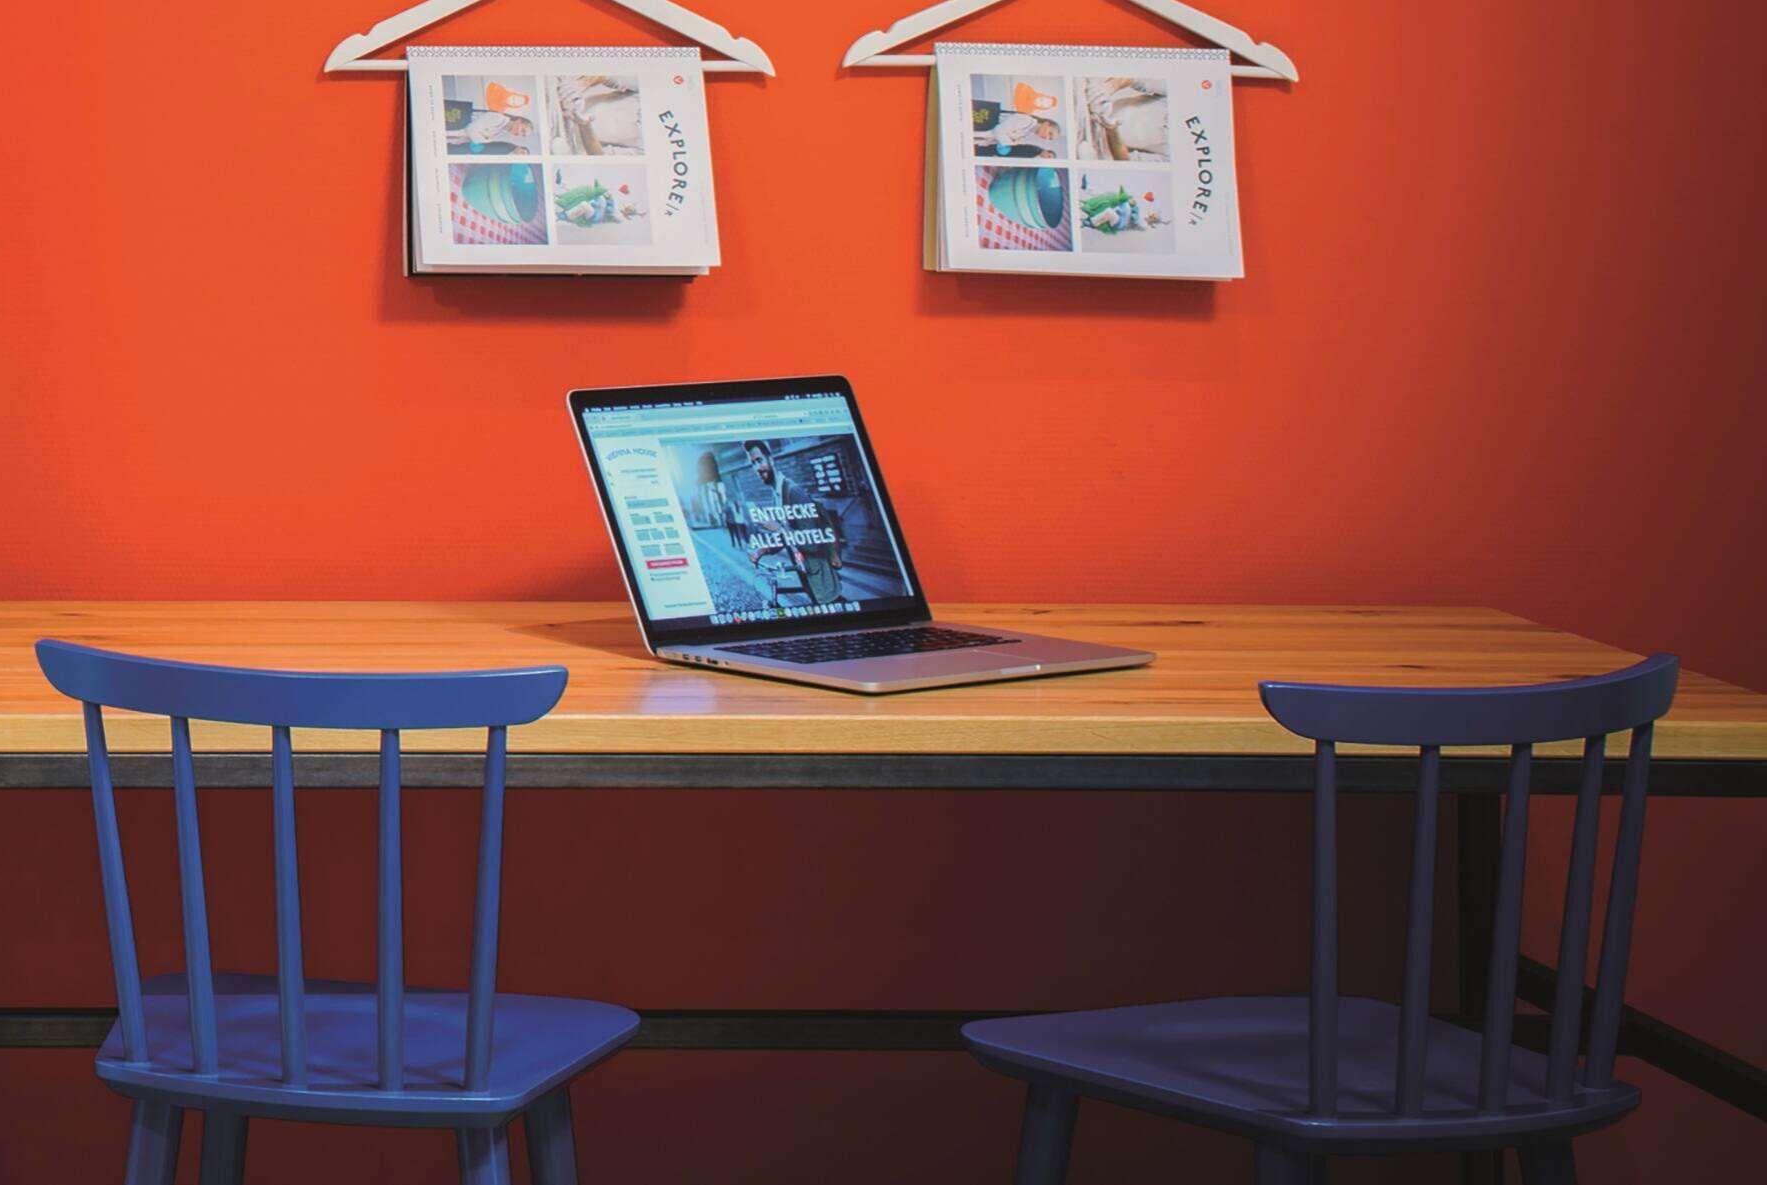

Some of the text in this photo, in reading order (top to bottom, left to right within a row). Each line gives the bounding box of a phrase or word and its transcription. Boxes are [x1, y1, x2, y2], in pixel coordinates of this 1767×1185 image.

[749, 503, 819, 523] ENTDECKE
[749, 527, 836, 549] ALLE HOTELS
